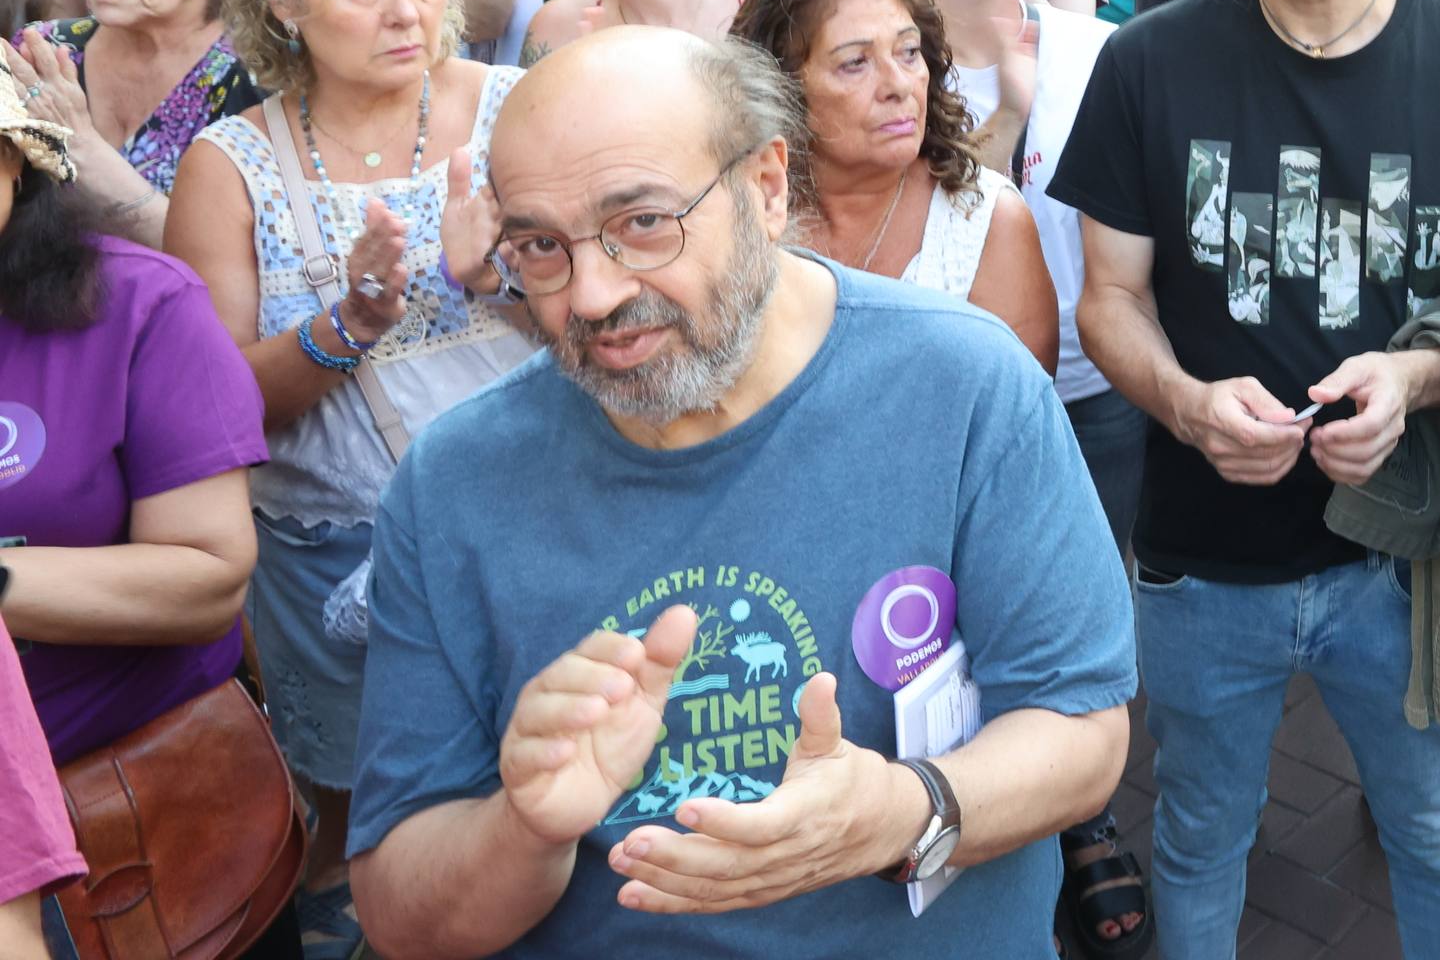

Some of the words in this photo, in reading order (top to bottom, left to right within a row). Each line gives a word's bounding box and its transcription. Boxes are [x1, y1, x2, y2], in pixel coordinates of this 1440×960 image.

[625, 566, 705, 617] EARTH
[716, 565, 740, 587] IS
[744, 571, 823, 677] SPEAKING
[896, 637, 943, 671] PODEMOS
[683, 684, 783, 737] TIME
[660, 724, 796, 784] LISTEN
